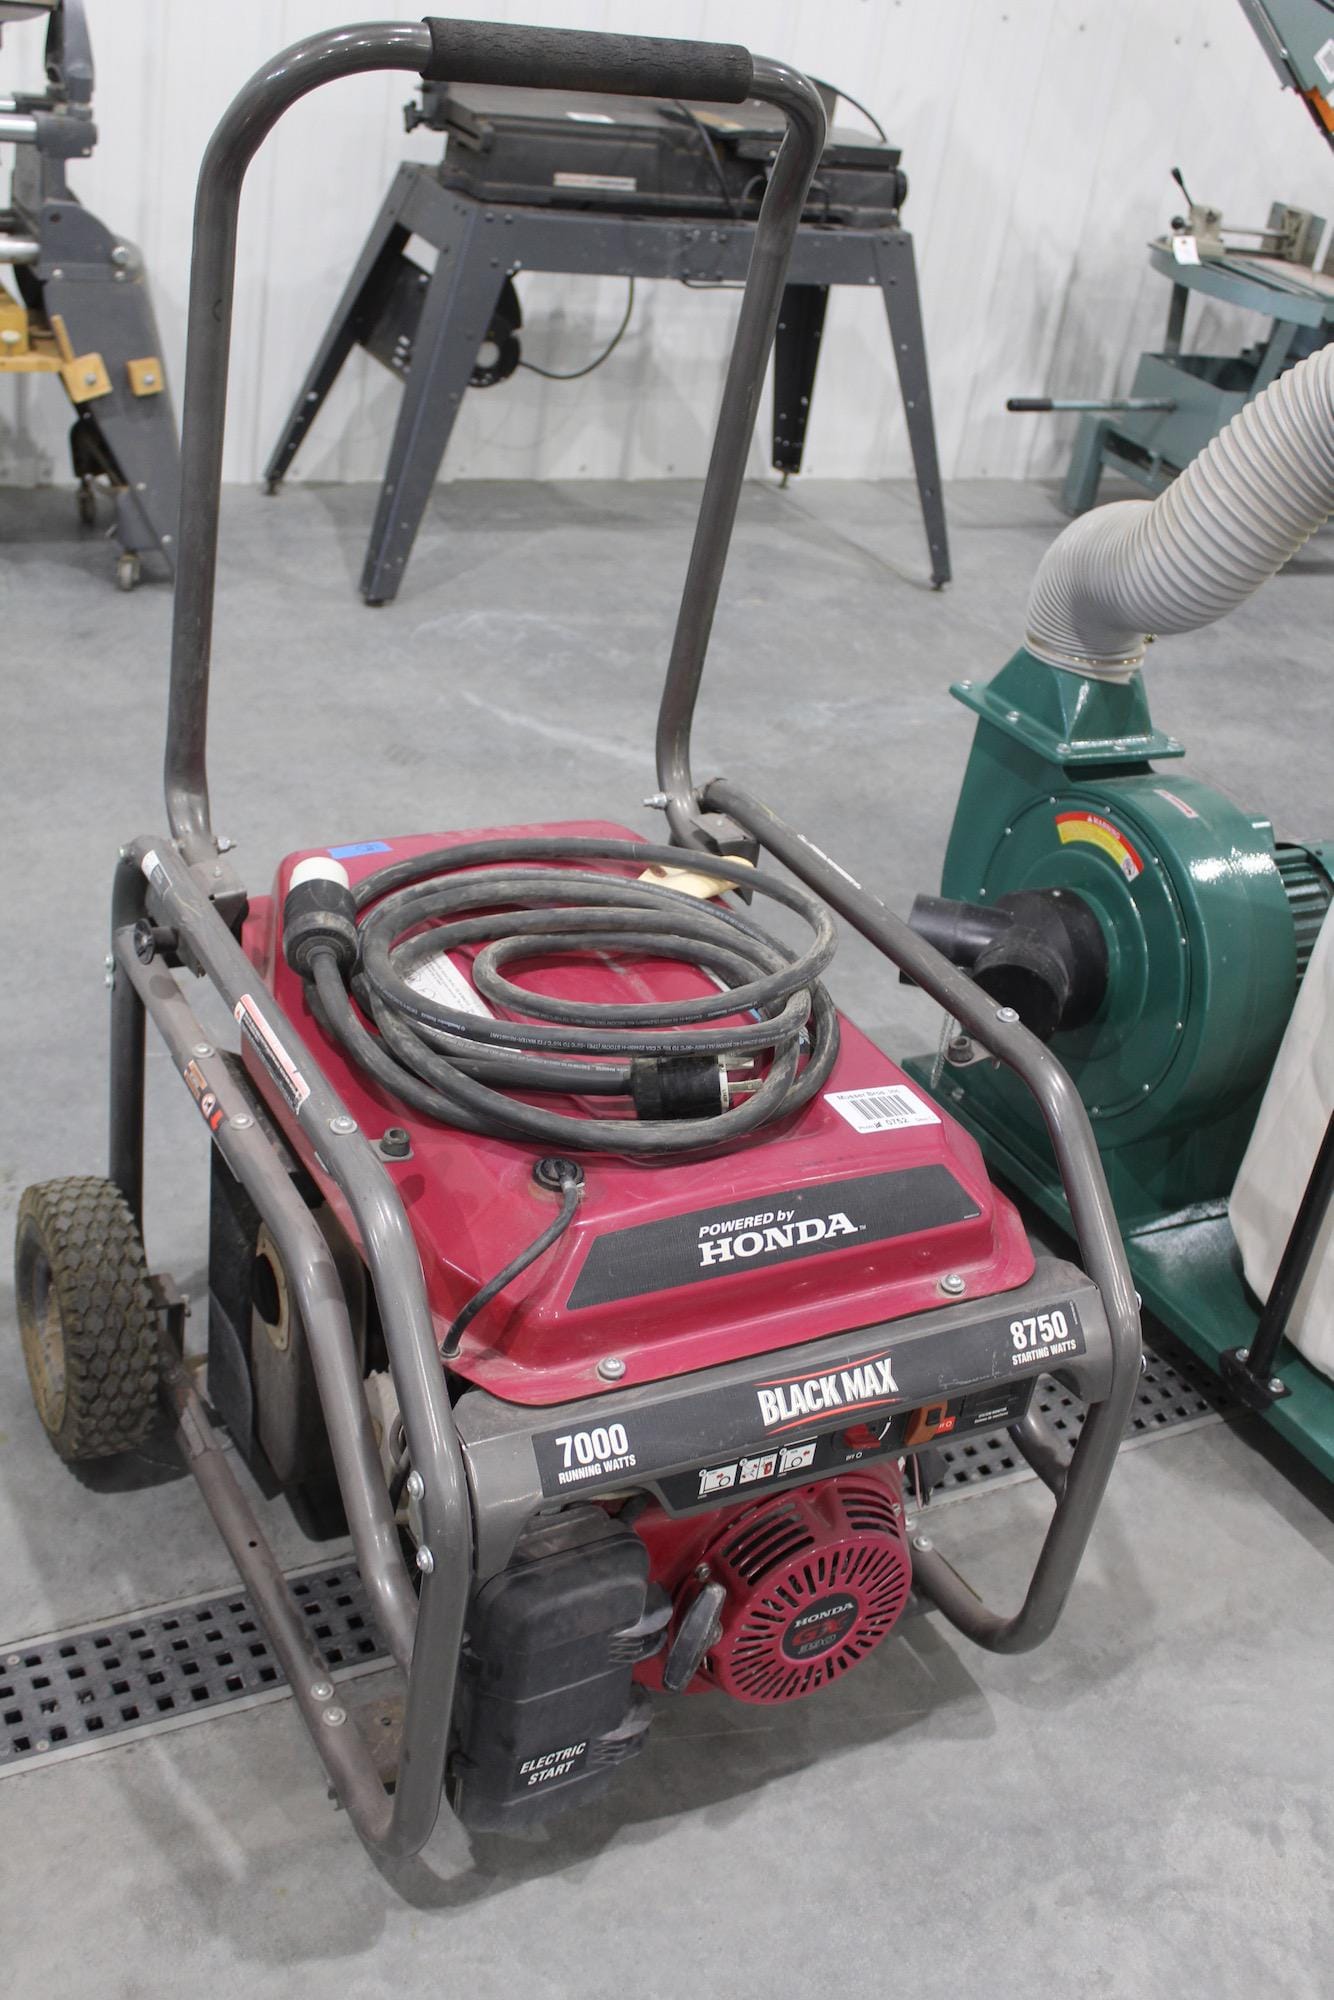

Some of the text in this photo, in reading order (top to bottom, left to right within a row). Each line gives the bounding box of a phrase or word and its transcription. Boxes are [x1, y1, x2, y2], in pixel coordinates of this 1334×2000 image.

[698, 1212, 858, 1267] HONDA
[699, 1210, 795, 1238] POWERED by
[1010, 1310, 1068, 1350] 8750
[1012, 1339, 1077, 1366] STARTING WATTS
[757, 1358, 899, 1427] BLACK MAX
[555, 1423, 629, 1468] 7000
[558, 1454, 637, 1485] RUNNING WATTS
[794, 1602, 854, 1629] HONDA
[520, 1742, 586, 1774] ELECTRIC
[528, 1760, 575, 1785] START
